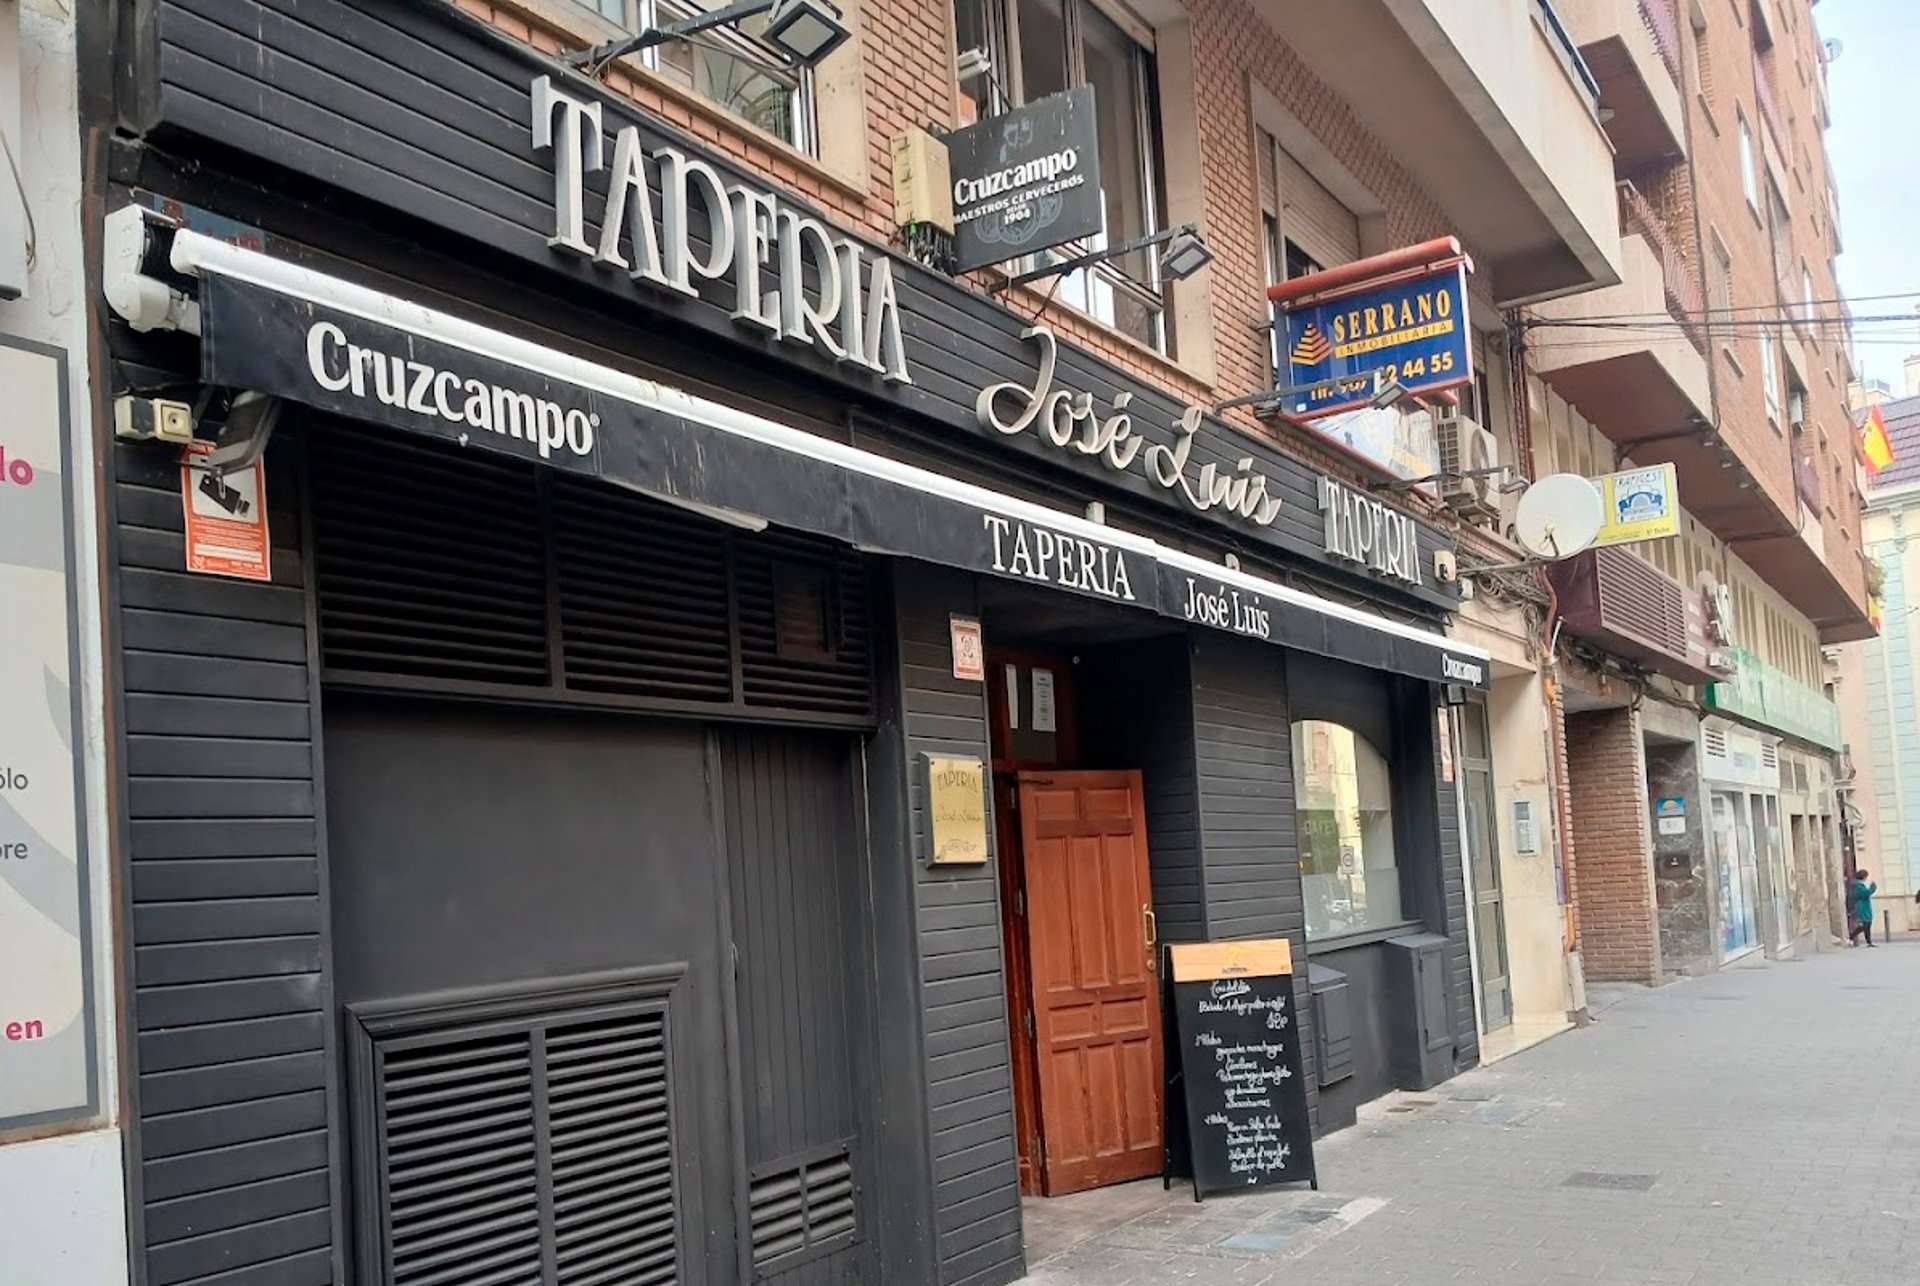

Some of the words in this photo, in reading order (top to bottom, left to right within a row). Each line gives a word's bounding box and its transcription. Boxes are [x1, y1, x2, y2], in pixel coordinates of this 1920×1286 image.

[954, 148, 1078, 206] Cruzcampo
[1011, 173, 1085, 206] CERVECEROS
[531, 74, 912, 384] TAPERIA
[1004, 208, 1031, 225] 1904
[1333, 289, 1451, 343] SERRANO
[1338, 322, 1449, 356] INMOBILIARIA
[306, 321, 594, 459] Cruzcampo
[1402, 357, 1426, 379] 44
[1430, 351, 1453, 374] 55
[976, 325, 1143, 470] José
[1145, 405, 1283, 526] Luis
[984, 515, 1136, 600] TAPERIA
[1316, 475, 1423, 586] TAPERIA
[1184, 577, 1230, 629] José
[1231, 591, 1271, 639] Luis
[5, 1020, 43, 1040] en
